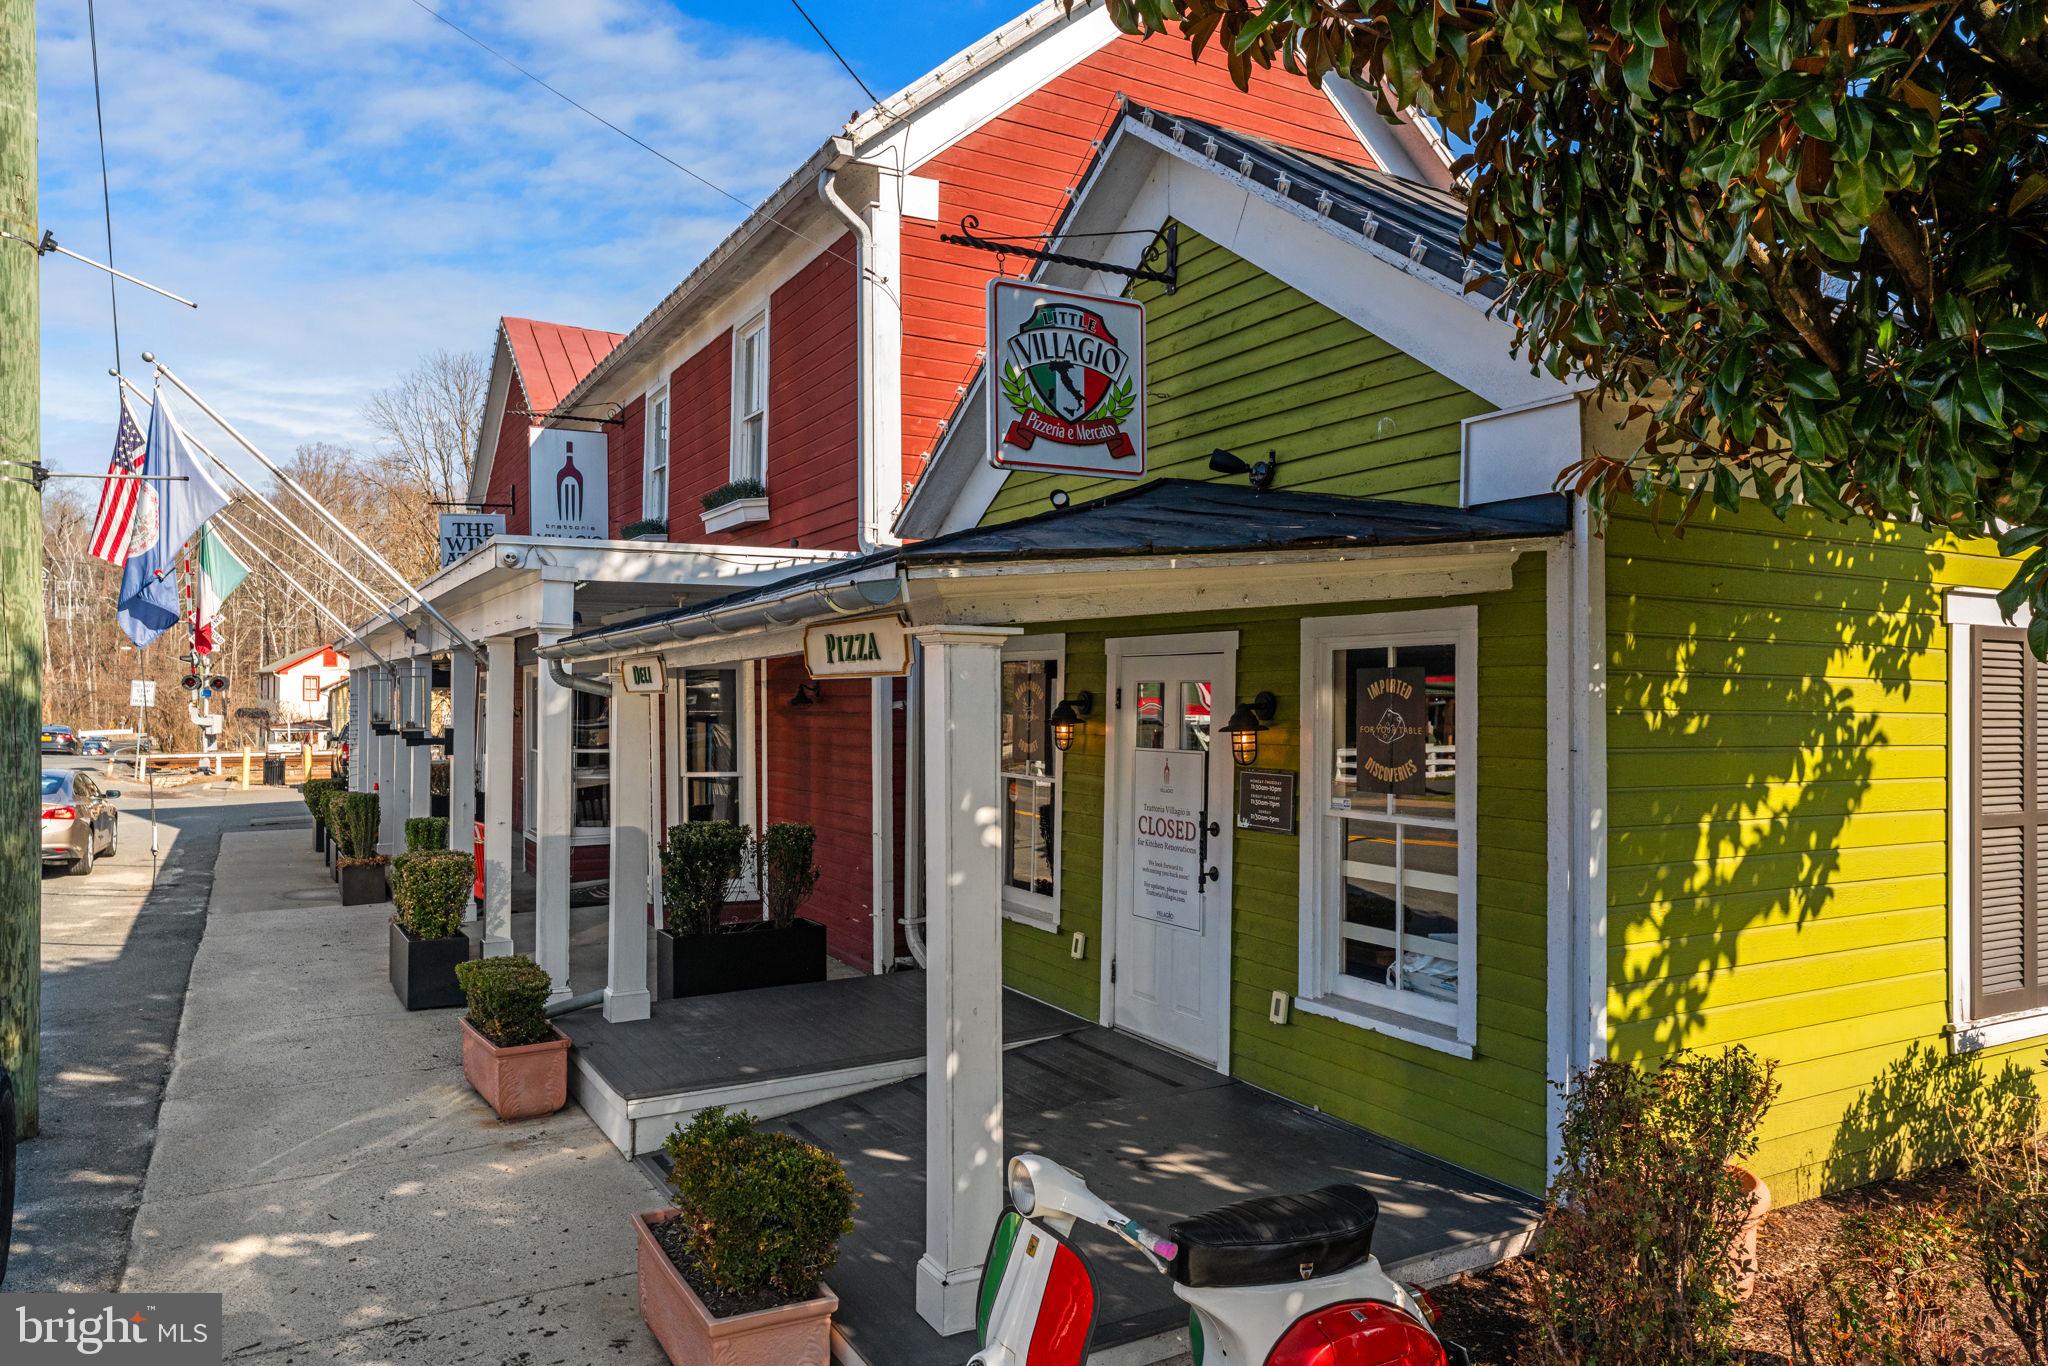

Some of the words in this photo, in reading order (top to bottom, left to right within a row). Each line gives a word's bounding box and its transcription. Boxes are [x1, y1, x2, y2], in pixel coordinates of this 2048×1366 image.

[1043, 311, 1096, 334] LITTLE
[1014, 332, 1121, 374] VILLAGIO
[1026, 411, 1065, 439] Pizzeria
[1067, 428, 1074, 439] e
[1076, 423, 1116, 441] Mercato
[452, 522, 494, 537] THE
[824, 632, 881, 664] PIZZA
[632, 665, 653, 685] DELI
[1367, 678, 1414, 700] IMPORTED
[1359, 725, 1375, 734] FOR
[1399, 726, 1423, 735] TABLE
[1364, 756, 1418, 783] DISCOVERIES
[1143, 803, 1165, 813] Trattoria
[1166, 806, 1185, 817] Villagio
[1138, 815, 1197, 842] CLOSED
[1145, 839, 1164, 849] Kitchen
[1165, 842, 1197, 855] Renovations
